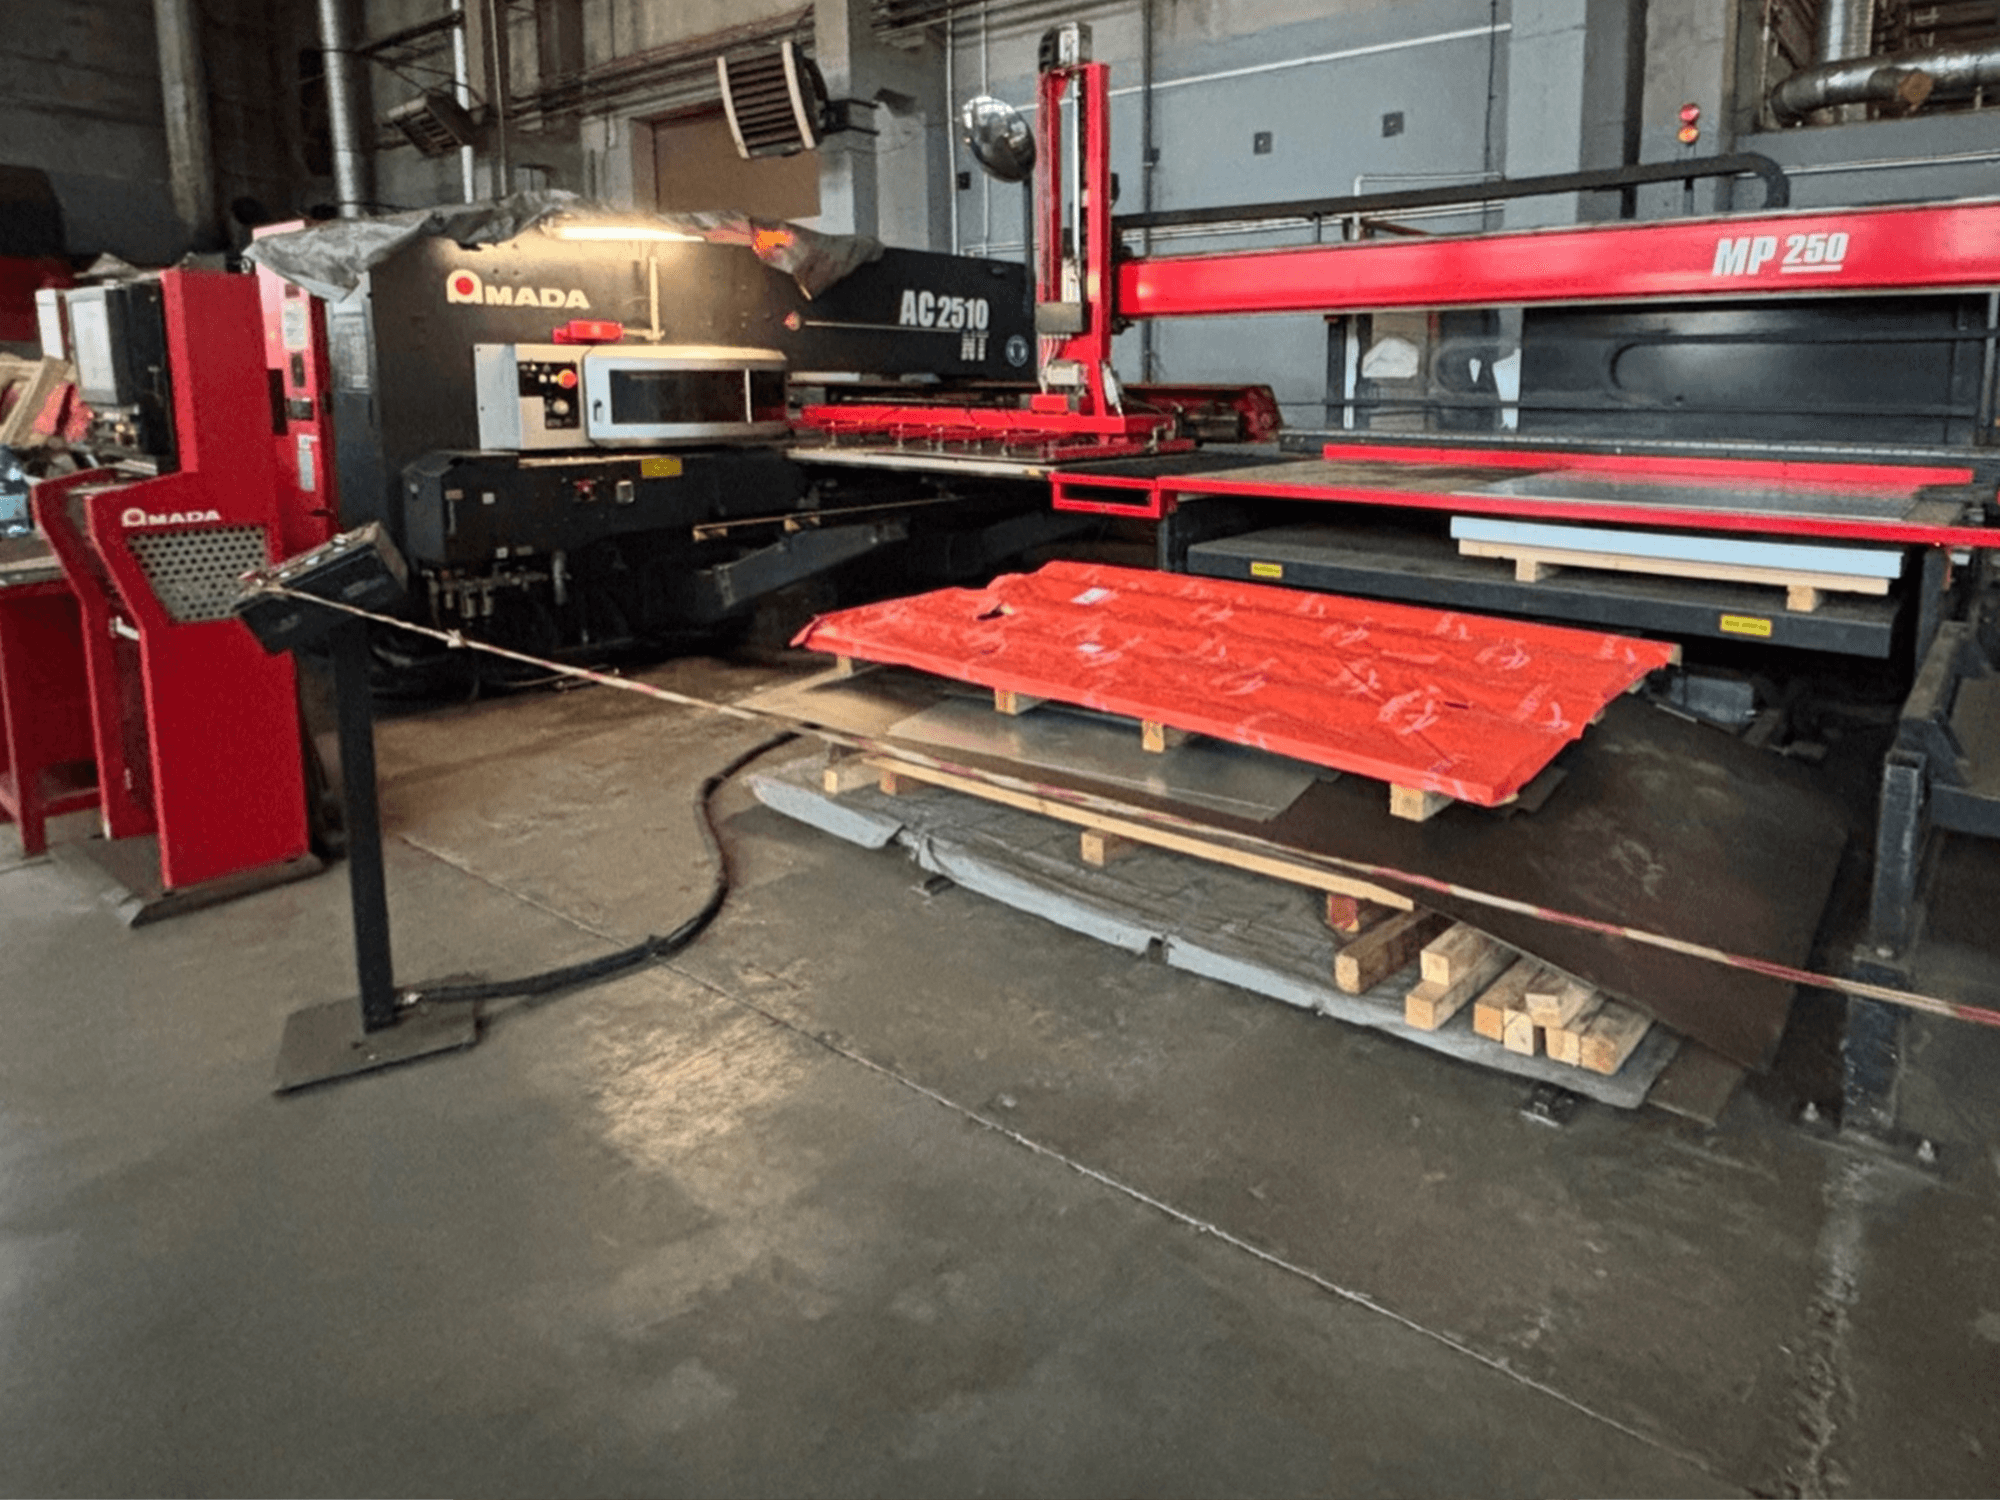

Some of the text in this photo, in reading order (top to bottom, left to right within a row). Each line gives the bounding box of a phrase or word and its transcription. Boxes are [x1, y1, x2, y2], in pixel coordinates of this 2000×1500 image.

[1712, 232, 1848, 276] MP 250
[447, 269, 590, 309] AMADA
[122, 508, 220, 527] AMADA
